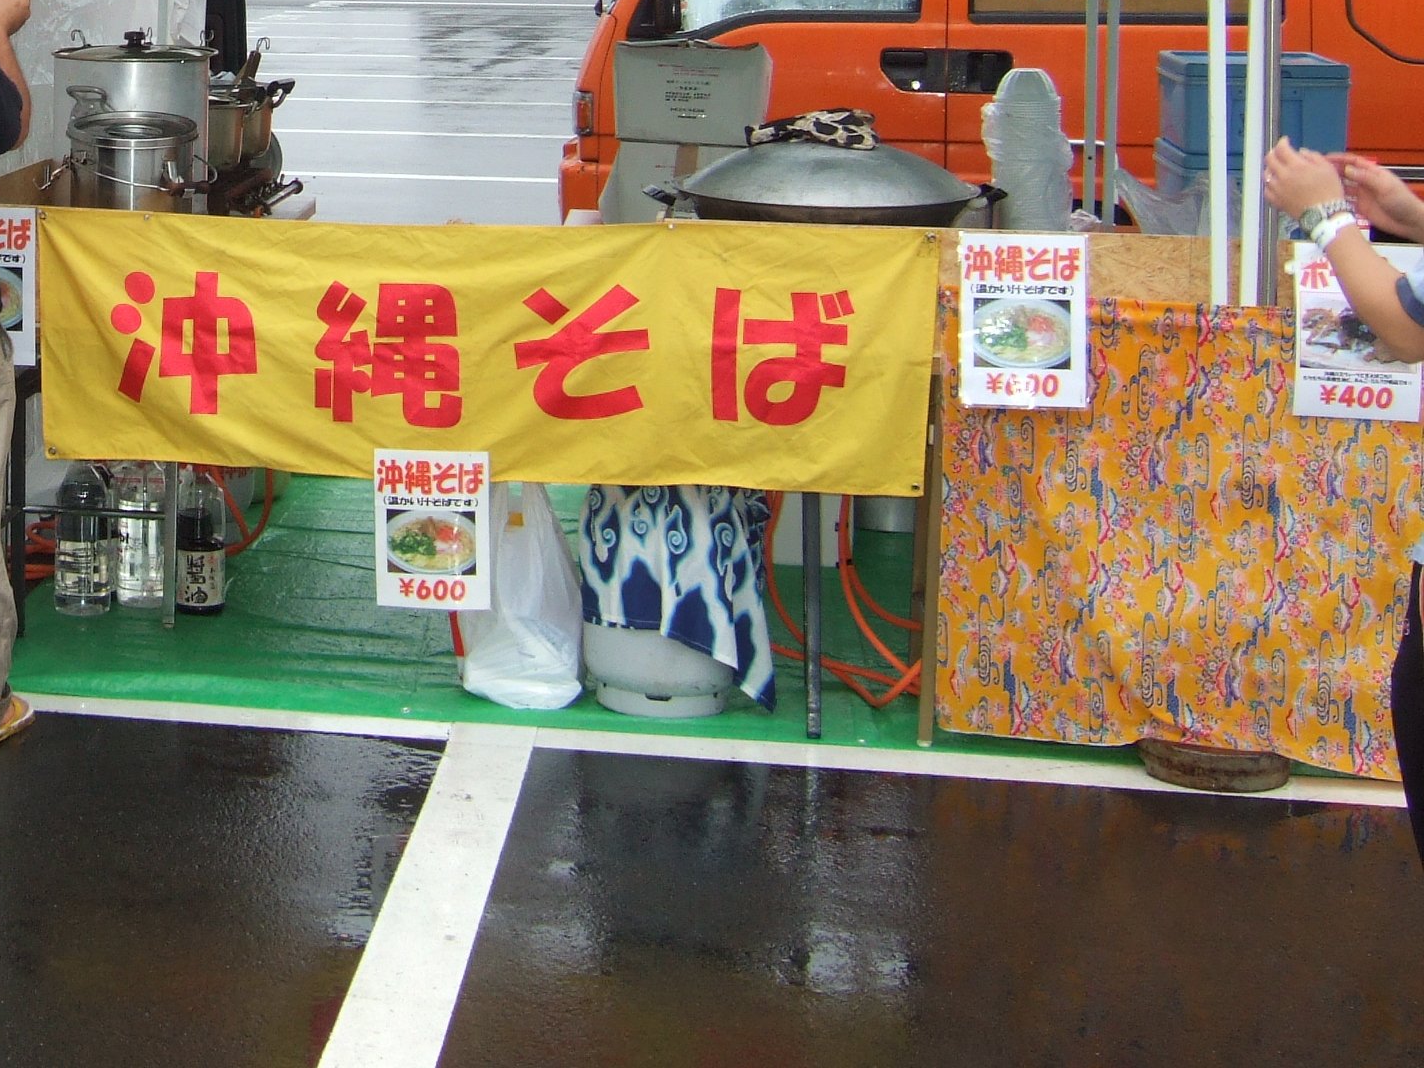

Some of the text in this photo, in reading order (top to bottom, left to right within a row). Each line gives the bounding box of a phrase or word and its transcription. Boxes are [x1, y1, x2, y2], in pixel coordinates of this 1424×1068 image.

[963, 244, 1081, 283] 沖縄そば
[110, 269, 856, 429] 沖縄そば
[1319, 383, 1394, 410] ¥400
[376, 458, 485, 496] 沖縄そば
[398, 577, 467, 603] ¥600
